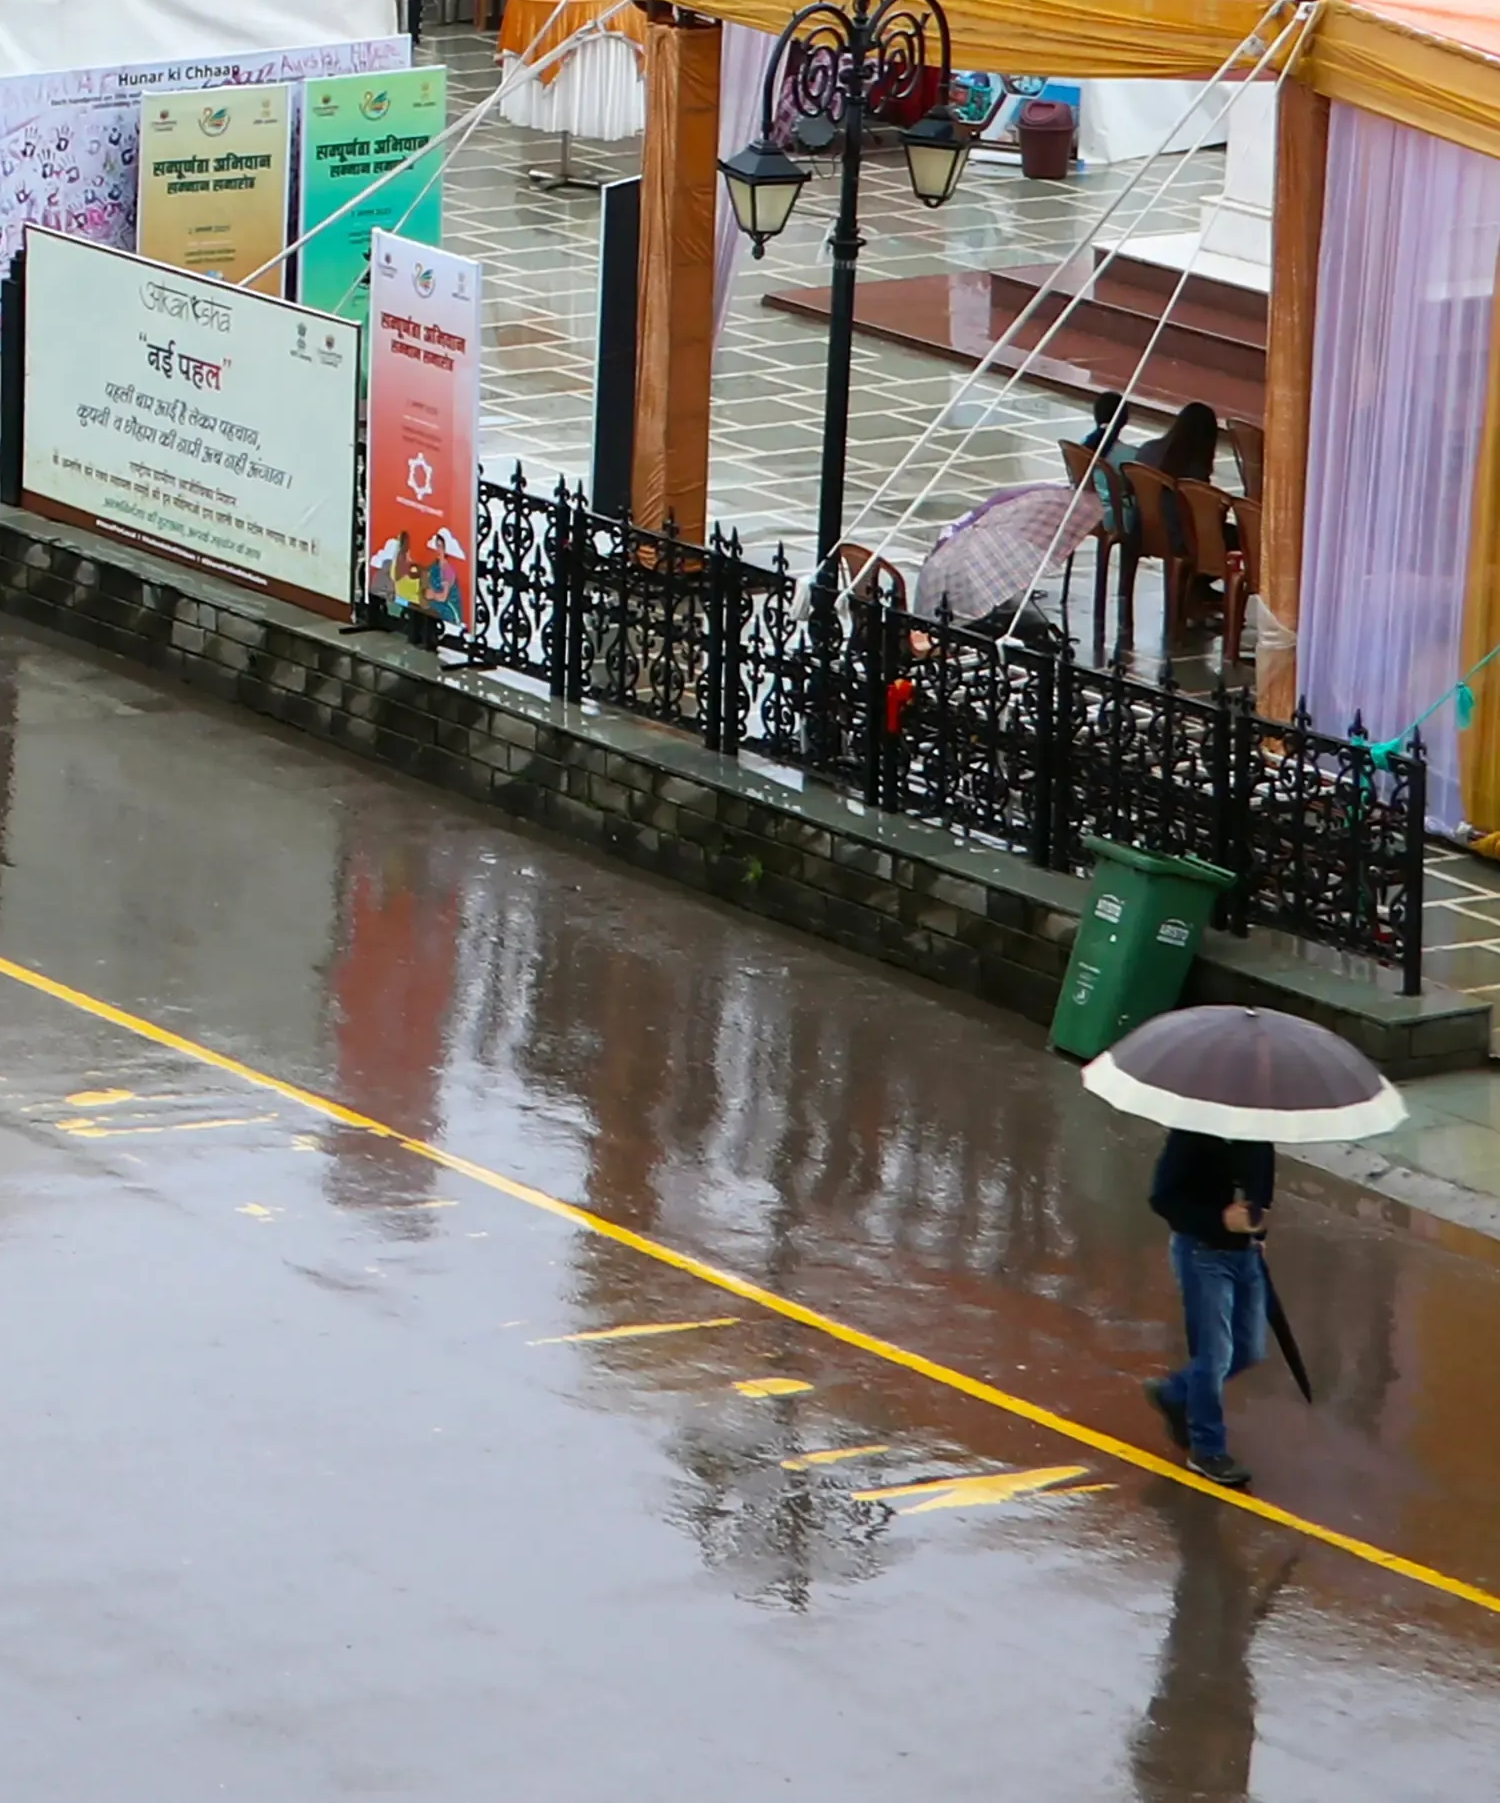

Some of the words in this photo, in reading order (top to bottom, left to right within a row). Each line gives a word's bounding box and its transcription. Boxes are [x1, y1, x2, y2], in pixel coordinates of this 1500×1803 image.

[118, 70, 164, 88] Hunar
[168, 67, 182, 82] ki
[184, 64, 241, 81] Chhaap
